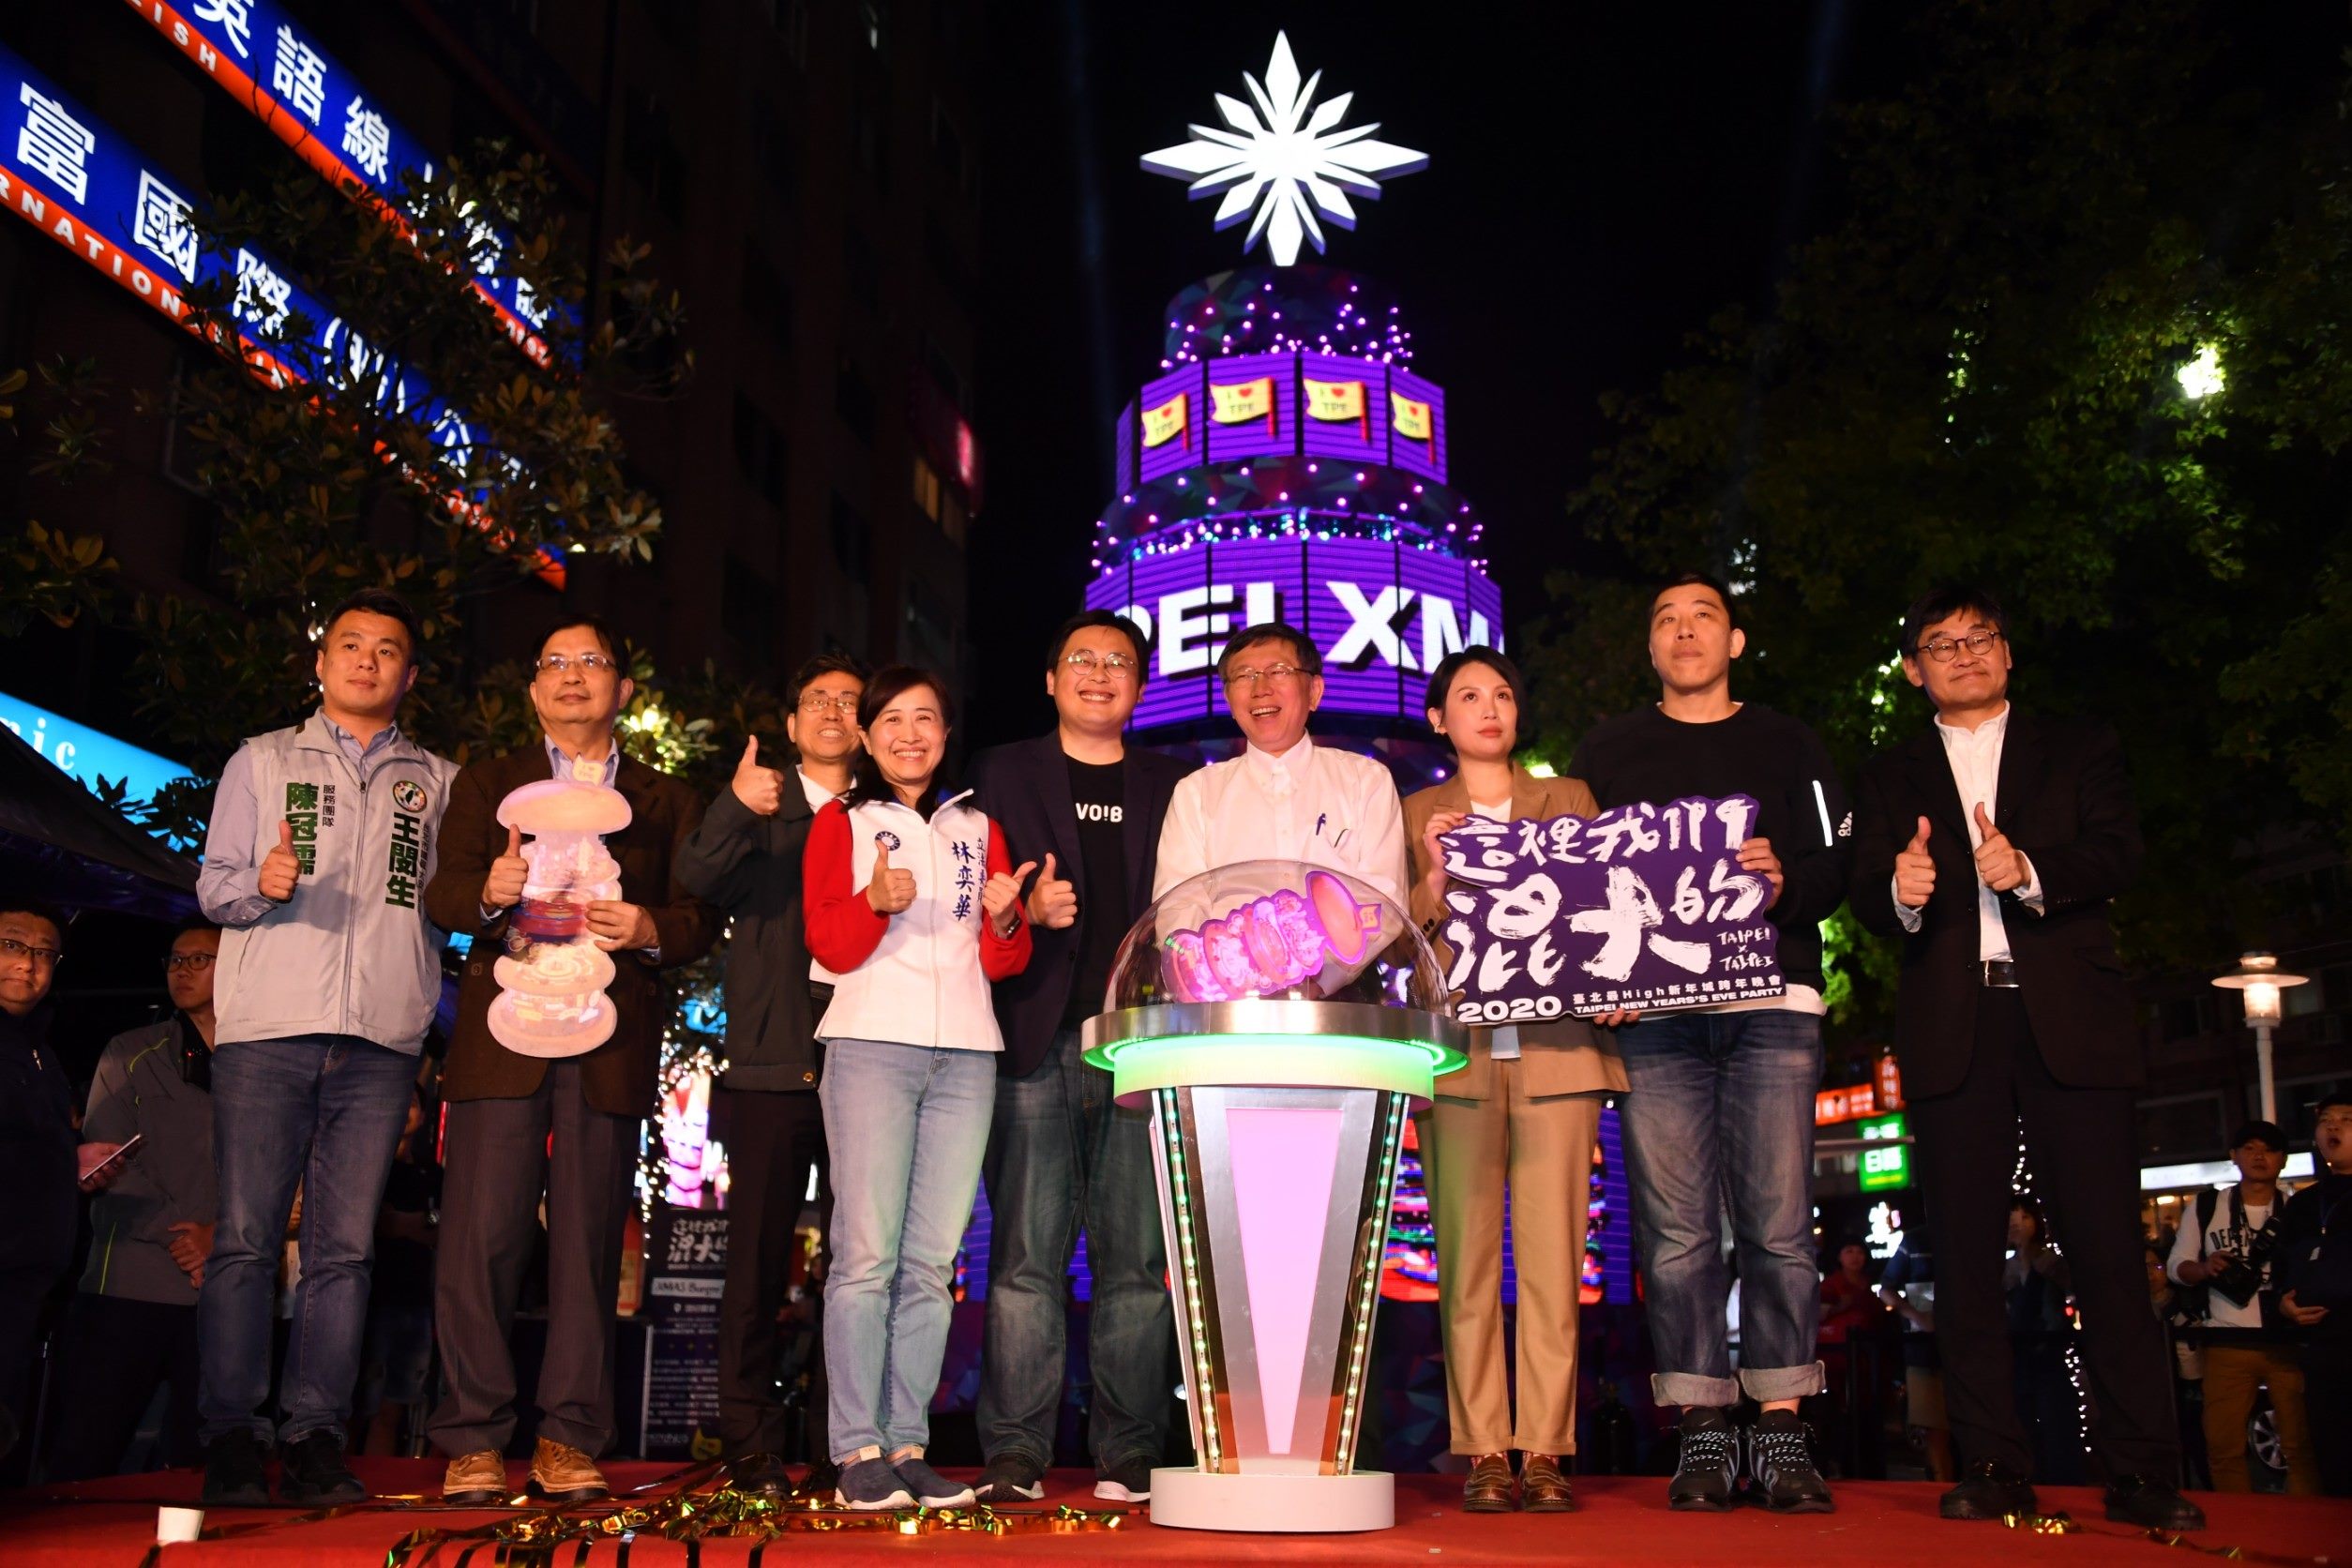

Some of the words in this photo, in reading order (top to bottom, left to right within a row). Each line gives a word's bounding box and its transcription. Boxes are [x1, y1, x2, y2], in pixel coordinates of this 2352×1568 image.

[132, 0, 217, 71] ISH
[322, 784, 336, 827] 服務團隊
[385, 812, 420, 910] 王閔生
[951, 840, 976, 921] 林奕華
[1445, 857, 1765, 995] 混大的
[1716, 927, 1771, 946] TAIPEI
[1719, 952, 1774, 972] TAIPEI
[1457, 996, 1562, 1022] 2020
[1575, 1003, 1617, 1015] TAIPEI
[1619, 1001, 1649, 1011] NEW
[1711, 991, 1738, 1003] EVE
[1740, 987, 1783, 1000] PARTY
